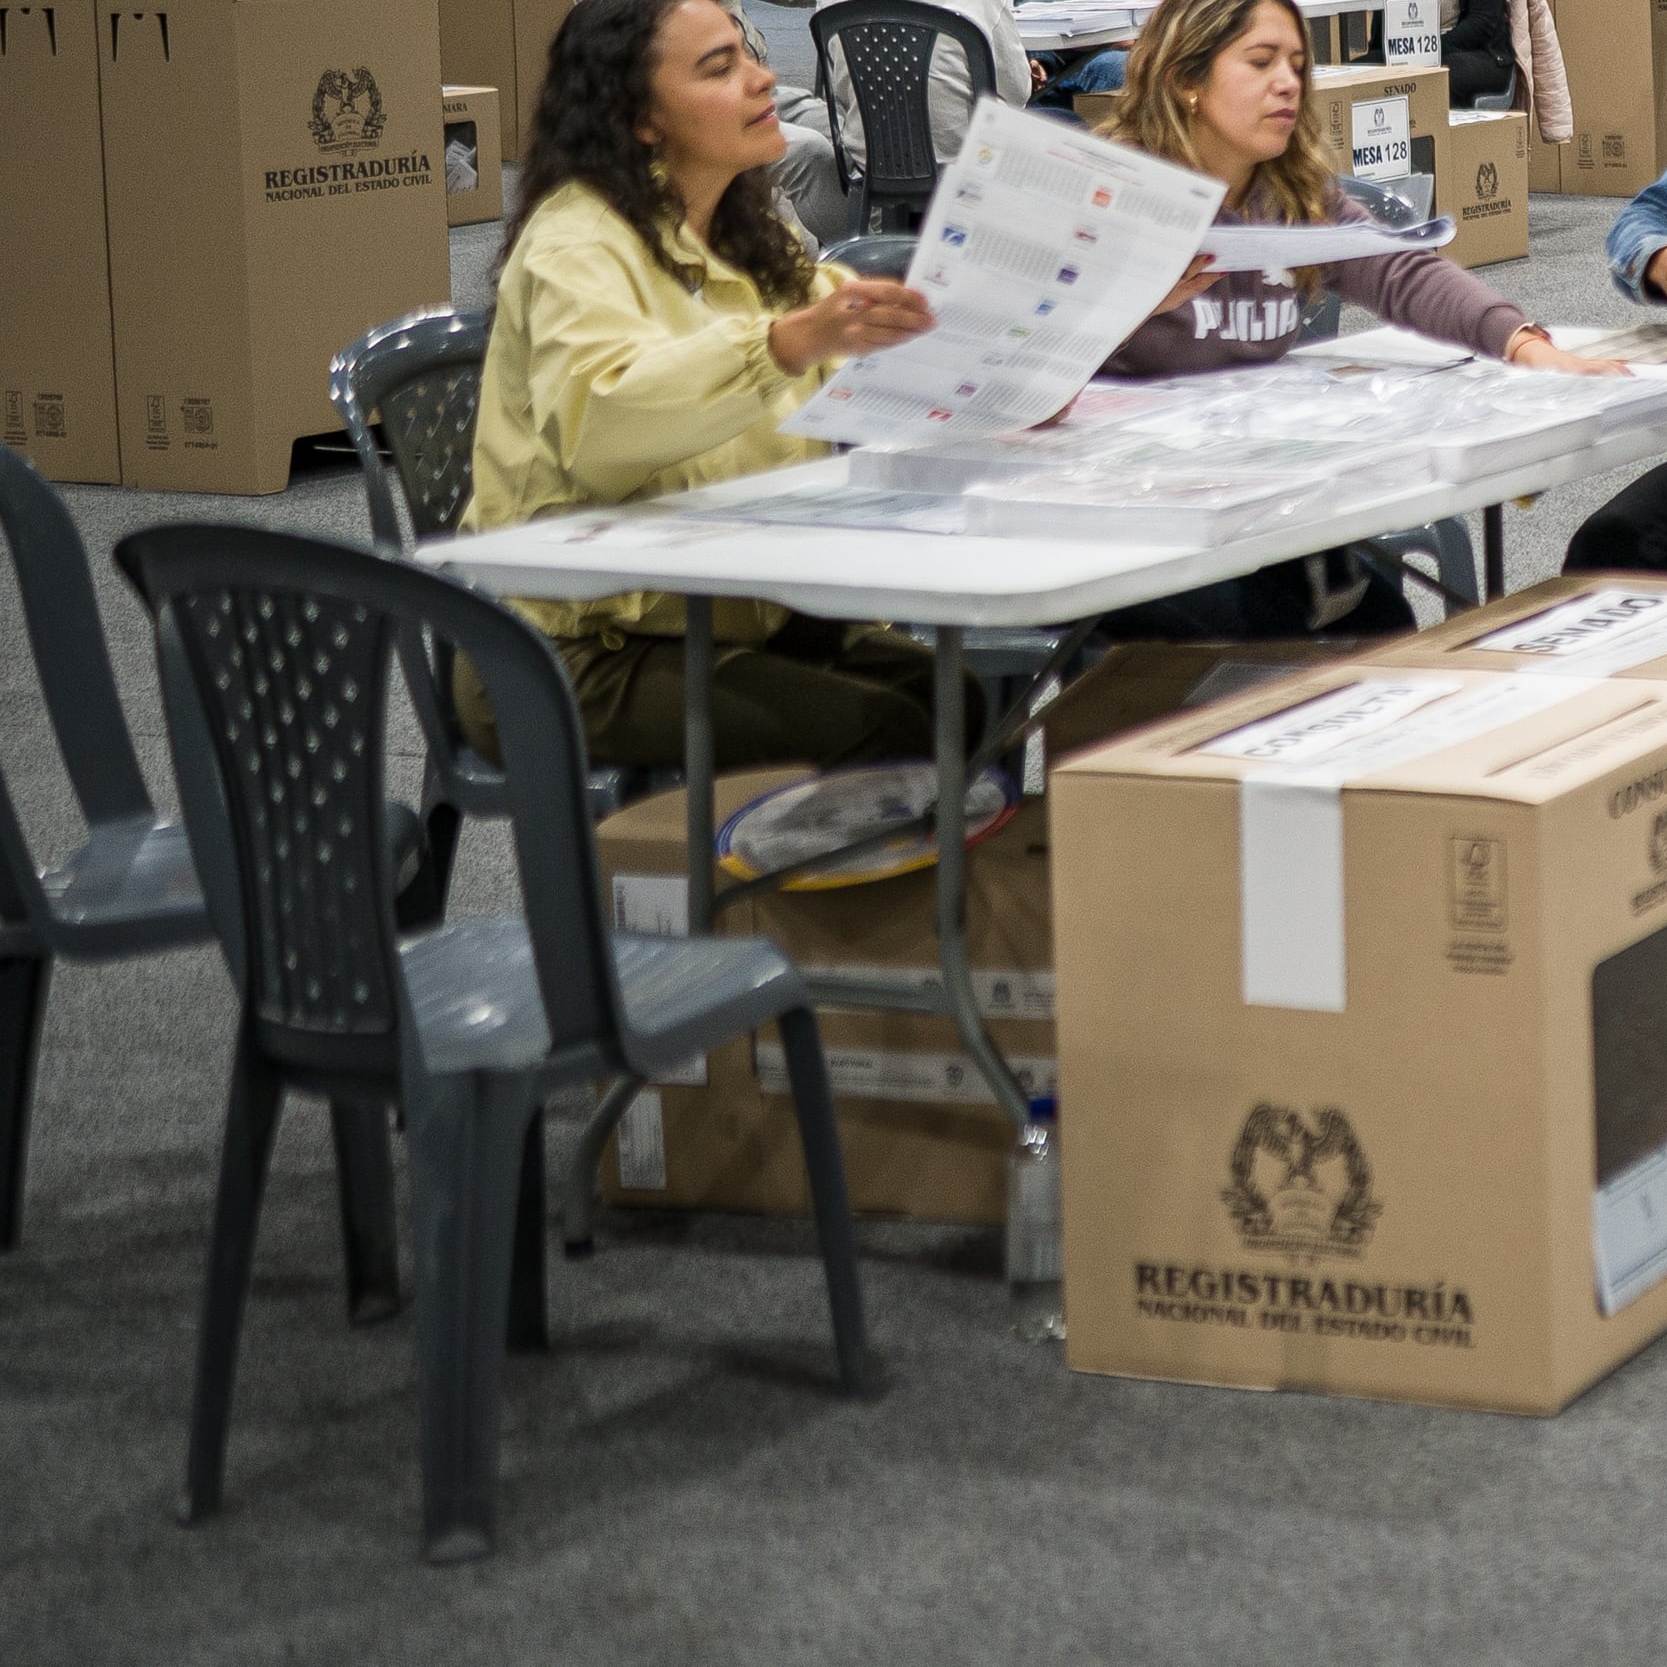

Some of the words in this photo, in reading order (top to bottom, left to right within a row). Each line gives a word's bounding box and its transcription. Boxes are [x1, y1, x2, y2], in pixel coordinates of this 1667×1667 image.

[1388, 38, 1415, 56] MESA
[1417, 35, 1438, 52] 128
[1384, 83, 1416, 94] SENADO
[1353, 148, 1382, 166] MESA
[1385, 142, 1407, 162] 128
[265, 150, 430, 189] REGISTRADURÍA
[266, 187, 324, 202] NACIONAL
[329, 184, 351, 195] DEL
[356, 178, 399, 192] ESTADO
[403, 174, 432, 187] CIVIL
[1135, 1263, 1473, 1324] REGISTRADURÍA
[1137, 1300, 1248, 1327] NACIONAL
[1260, 1309, 1300, 1332] DEL
[1314, 1316, 1405, 1342] ESTADO
[1412, 1326, 1474, 1349] CIVIL
